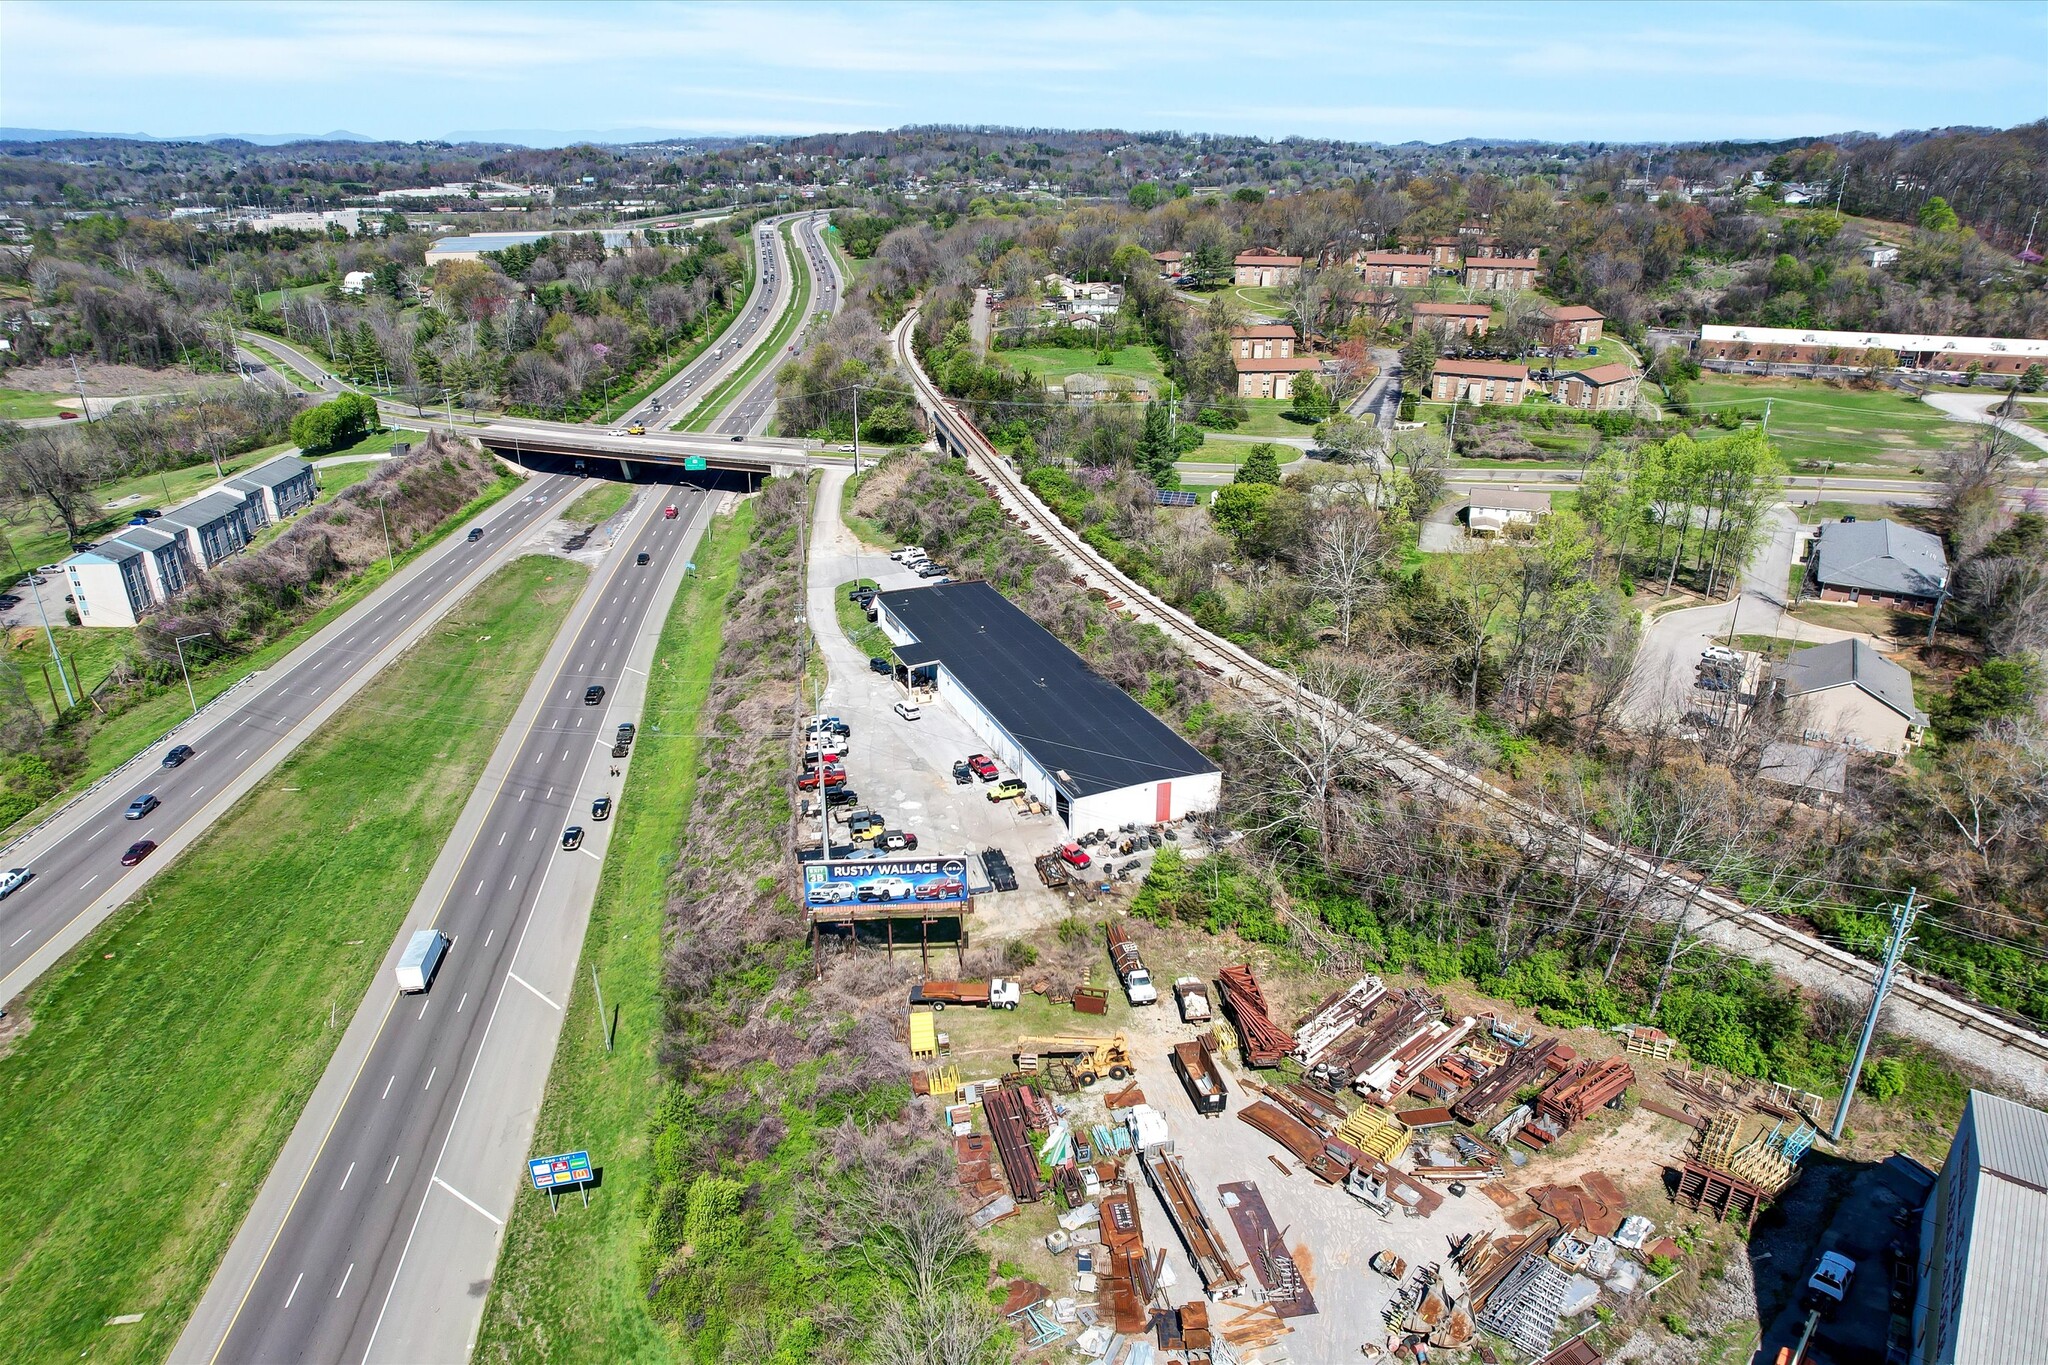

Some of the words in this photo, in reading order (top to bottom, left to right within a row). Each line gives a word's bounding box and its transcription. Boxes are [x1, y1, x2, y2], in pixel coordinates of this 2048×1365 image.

[834, 865, 874, 876] RUSTY
[878, 863, 938, 874] WALLACE
[810, 874, 825, 882] 3B
